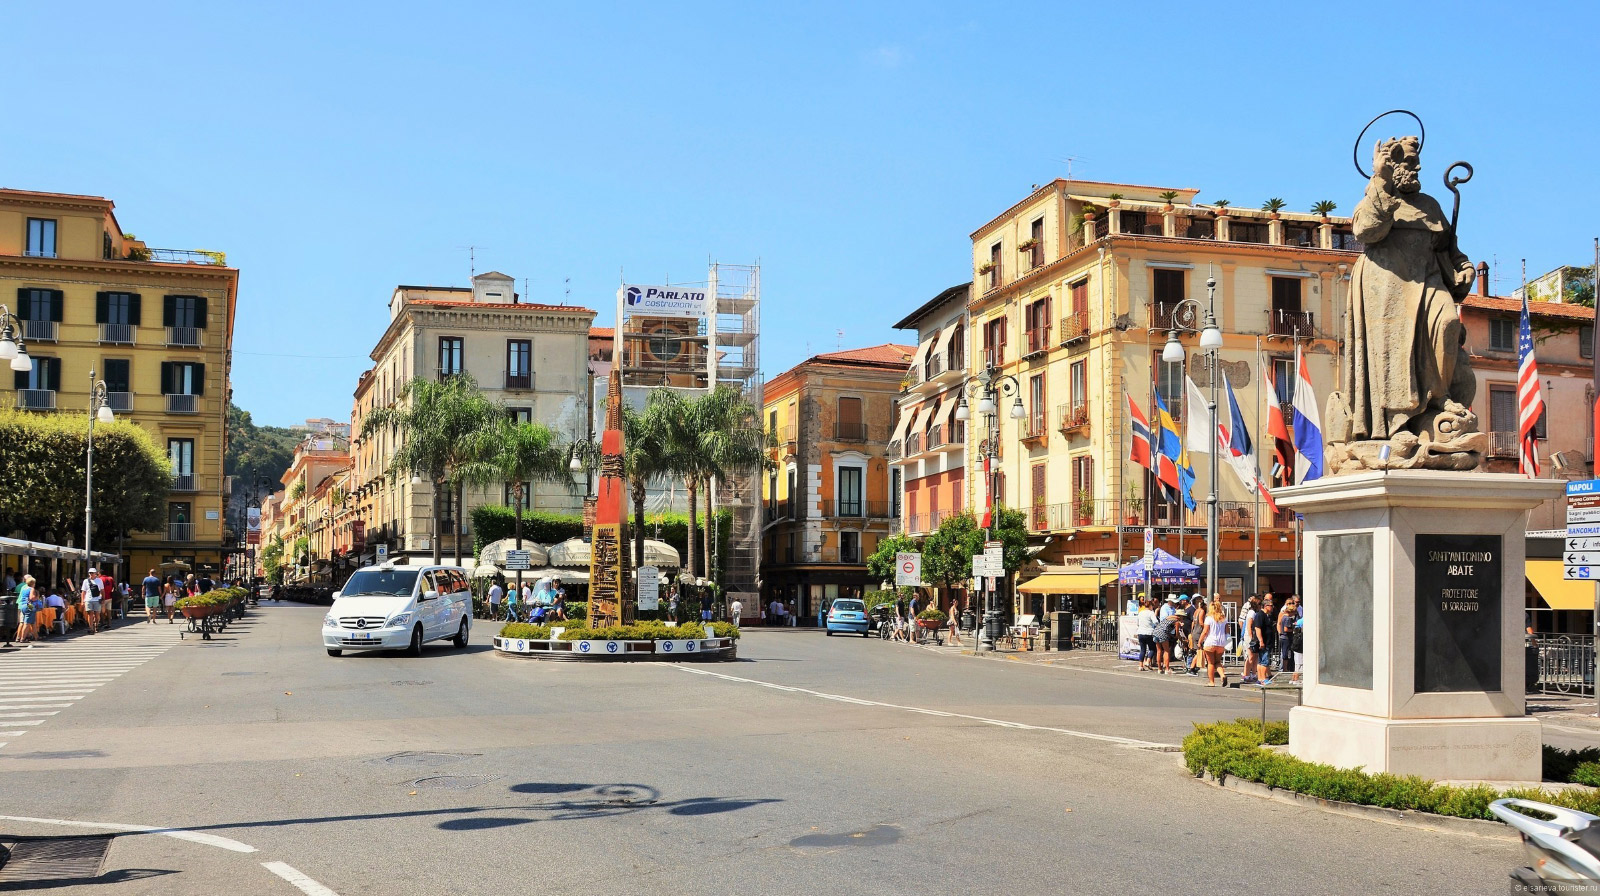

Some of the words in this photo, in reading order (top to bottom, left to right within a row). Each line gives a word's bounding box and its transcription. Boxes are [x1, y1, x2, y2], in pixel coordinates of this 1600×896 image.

[646, 288, 705, 301] PARLATO
[645, 299, 692, 309] costruzioni
[1568, 482, 1593, 492] NAPOLI
[1568, 527, 1600, 535] BANCOMAT
[1428, 550, 1492, 562] SANT'ANTONINO
[1447, 565, 1474, 576] ABATE
[1441, 588, 1479, 599] PROTETTORE
[1441, 601, 1448, 612] DI
[1449, 601, 1479, 612] SORRENTO
